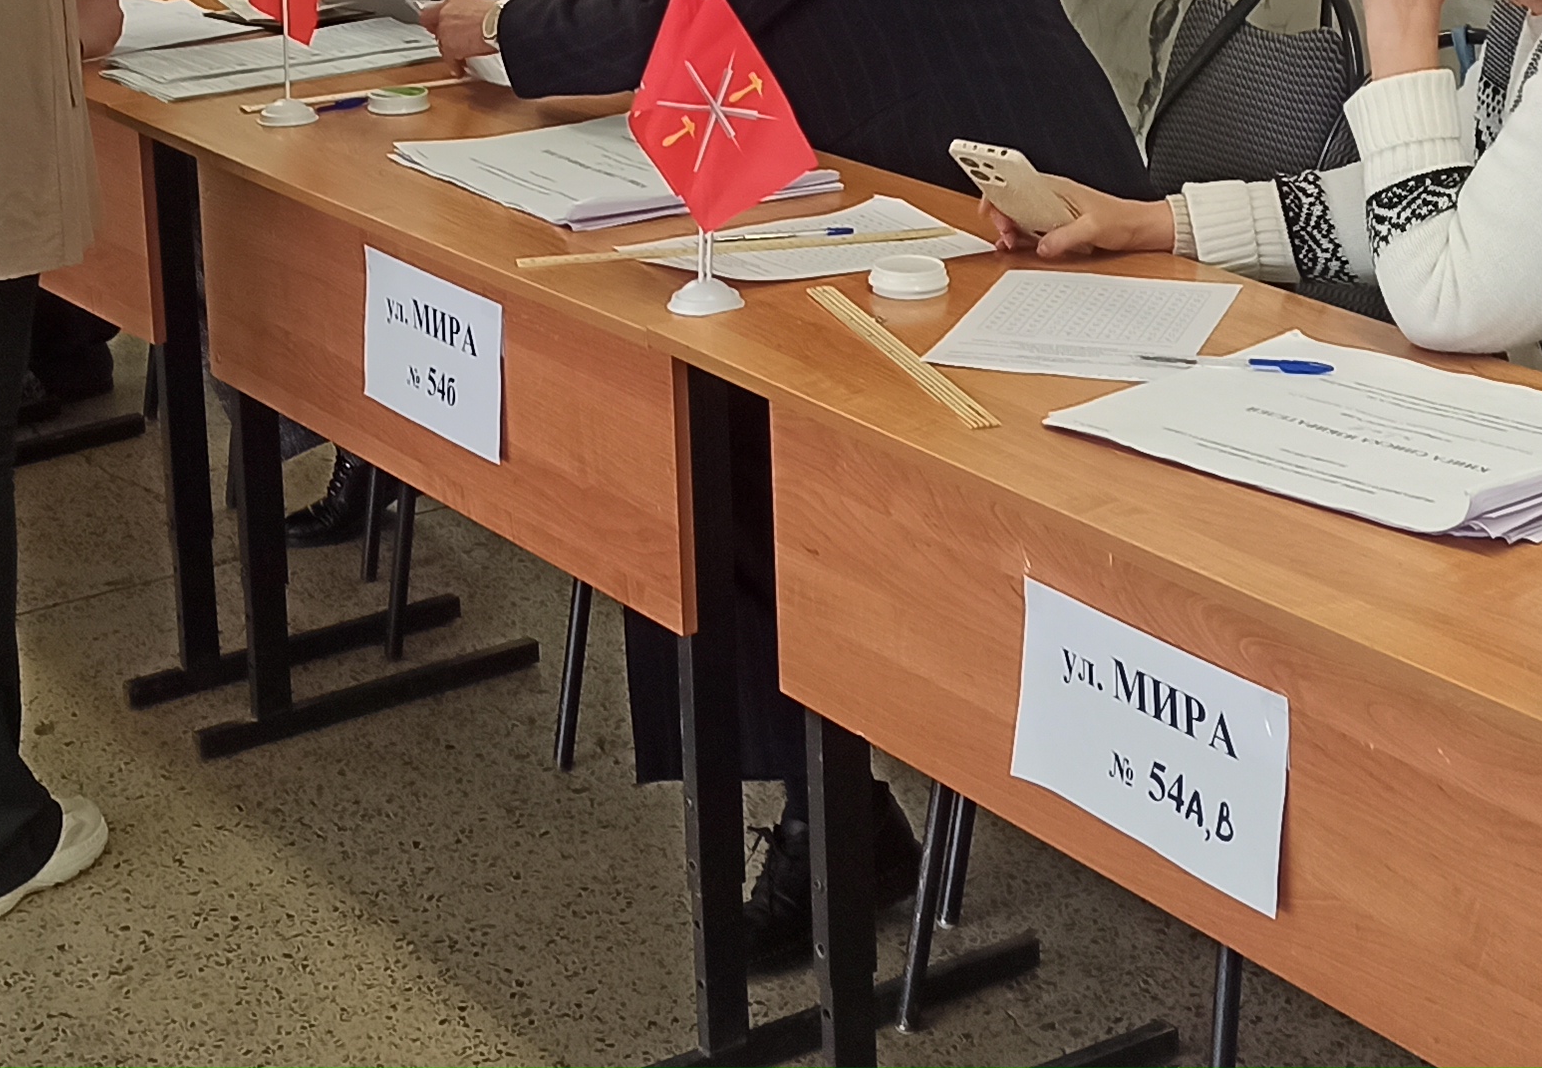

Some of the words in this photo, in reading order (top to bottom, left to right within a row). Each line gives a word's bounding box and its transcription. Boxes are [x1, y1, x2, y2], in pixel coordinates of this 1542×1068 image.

[385, 297, 408, 324] ул.
[411, 298, 478, 357] МИРА
[1061, 646, 1103, 691] ул.
[1111, 656, 1239, 761] МИРА
[1108, 750, 1134, 787] №
